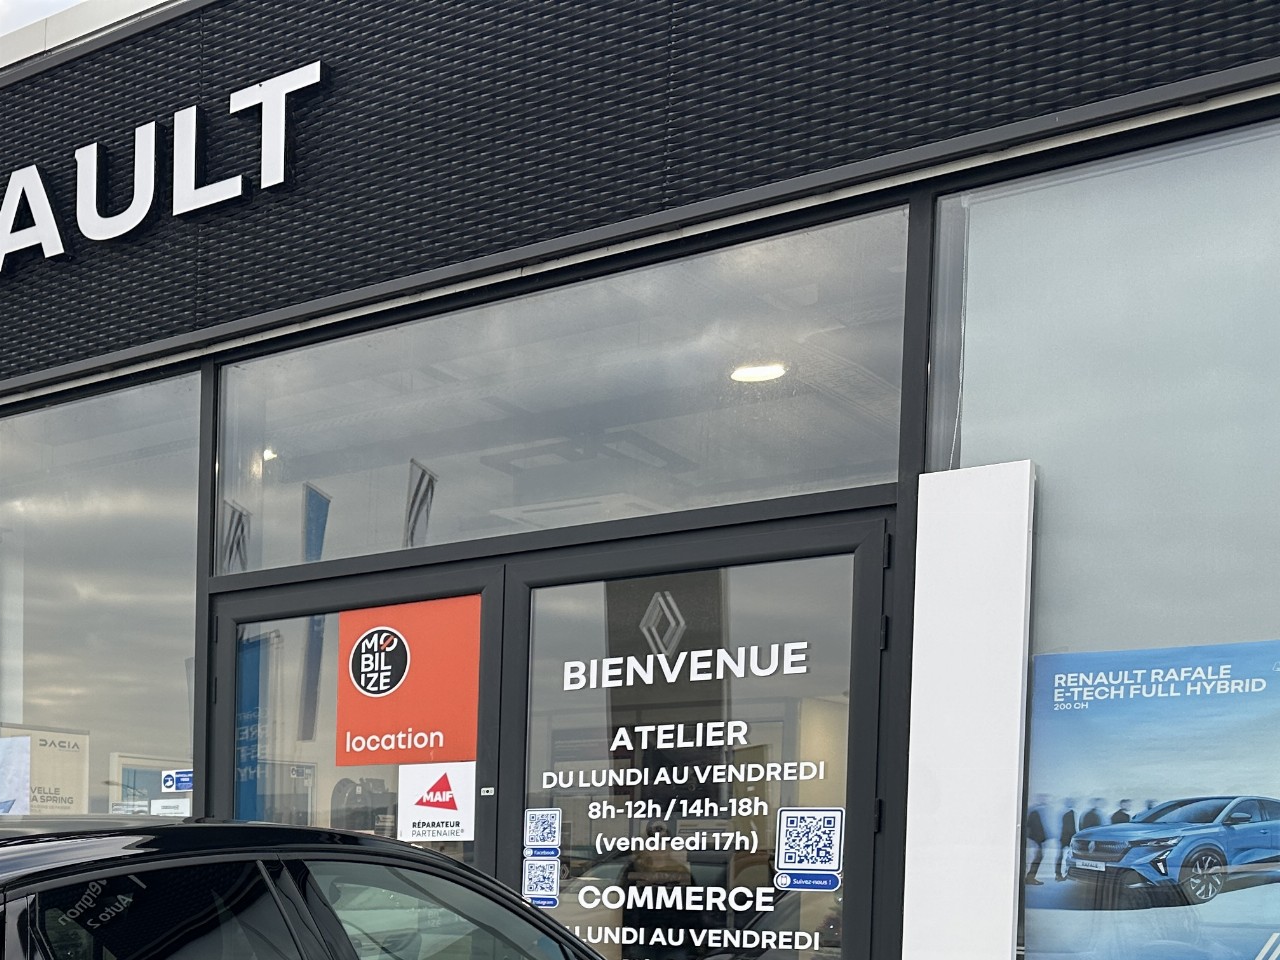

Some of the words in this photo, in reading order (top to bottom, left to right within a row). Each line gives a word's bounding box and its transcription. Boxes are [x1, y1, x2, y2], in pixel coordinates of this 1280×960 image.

[563, 641, 808, 691] BIENVENUE
[1054, 669, 1146, 687] RENAULT
[1150, 664, 1232, 683] RAFALE
[1053, 686, 1124, 701] E-TECH
[1129, 684, 1181, 699] FULL
[1186, 678, 1267, 696] HYBRID
[1053, 702, 1072, 711] 200
[1073, 701, 1089, 710] CH
[39, 738, 80, 750] DACIA
[345, 728, 444, 752] location
[610, 720, 748, 752] ATELIER
[542, 770, 574, 789] DU
[578, 767, 649, 788] LUNDI
[654, 766, 688, 785] AU
[693, 760, 825, 783] VENDREDI
[40, 796, 74, 805] SPRING
[422, 790, 453, 803] MAIF
[588, 799, 662, 819] 8h-12h
[680, 797, 768, 817] 14h-18h
[412, 819, 461, 828] RÉPARATEUR
[595, 831, 707, 854] (vendredi
[712, 831, 759, 854] 17h)
[578, 886, 775, 912] COMMERCE
[649, 927, 685, 946] AU
[692, 929, 820, 950] VENDREDI
